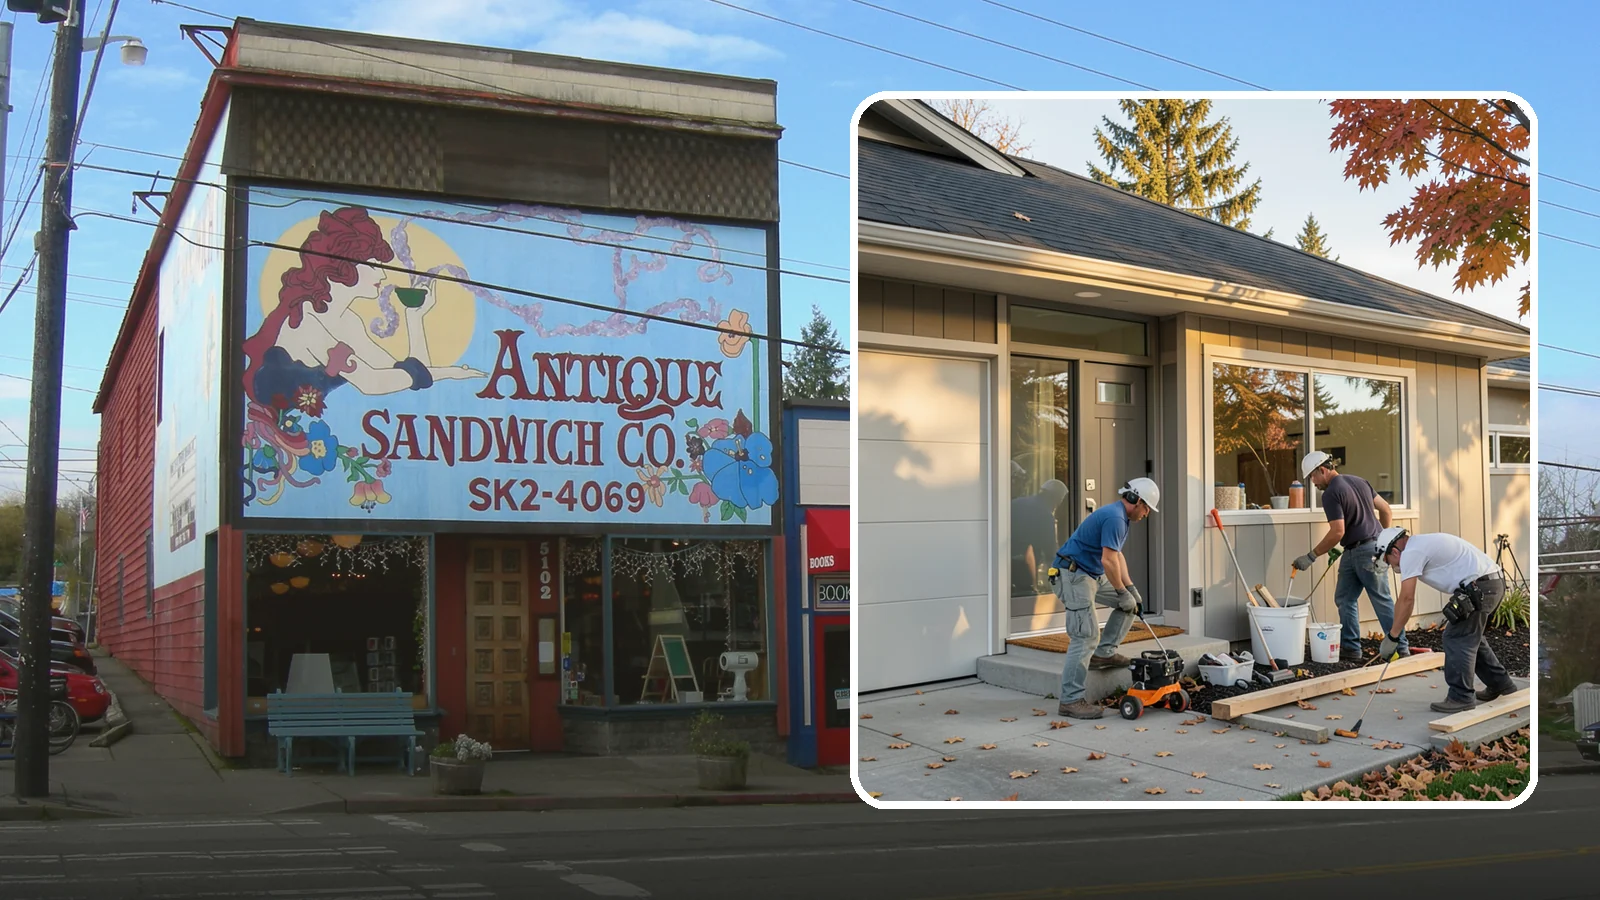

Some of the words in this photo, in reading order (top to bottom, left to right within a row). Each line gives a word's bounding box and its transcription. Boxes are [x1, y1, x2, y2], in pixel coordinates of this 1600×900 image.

[475, 329, 724, 421] ANTIQUE
[361, 409, 605, 468] SANDWICH
[616, 422, 685, 468] CO.
[468, 477, 646, 514] SK2-4069
[540, 541, 552, 600] 5102
[809, 555, 835, 569] BOOKS
